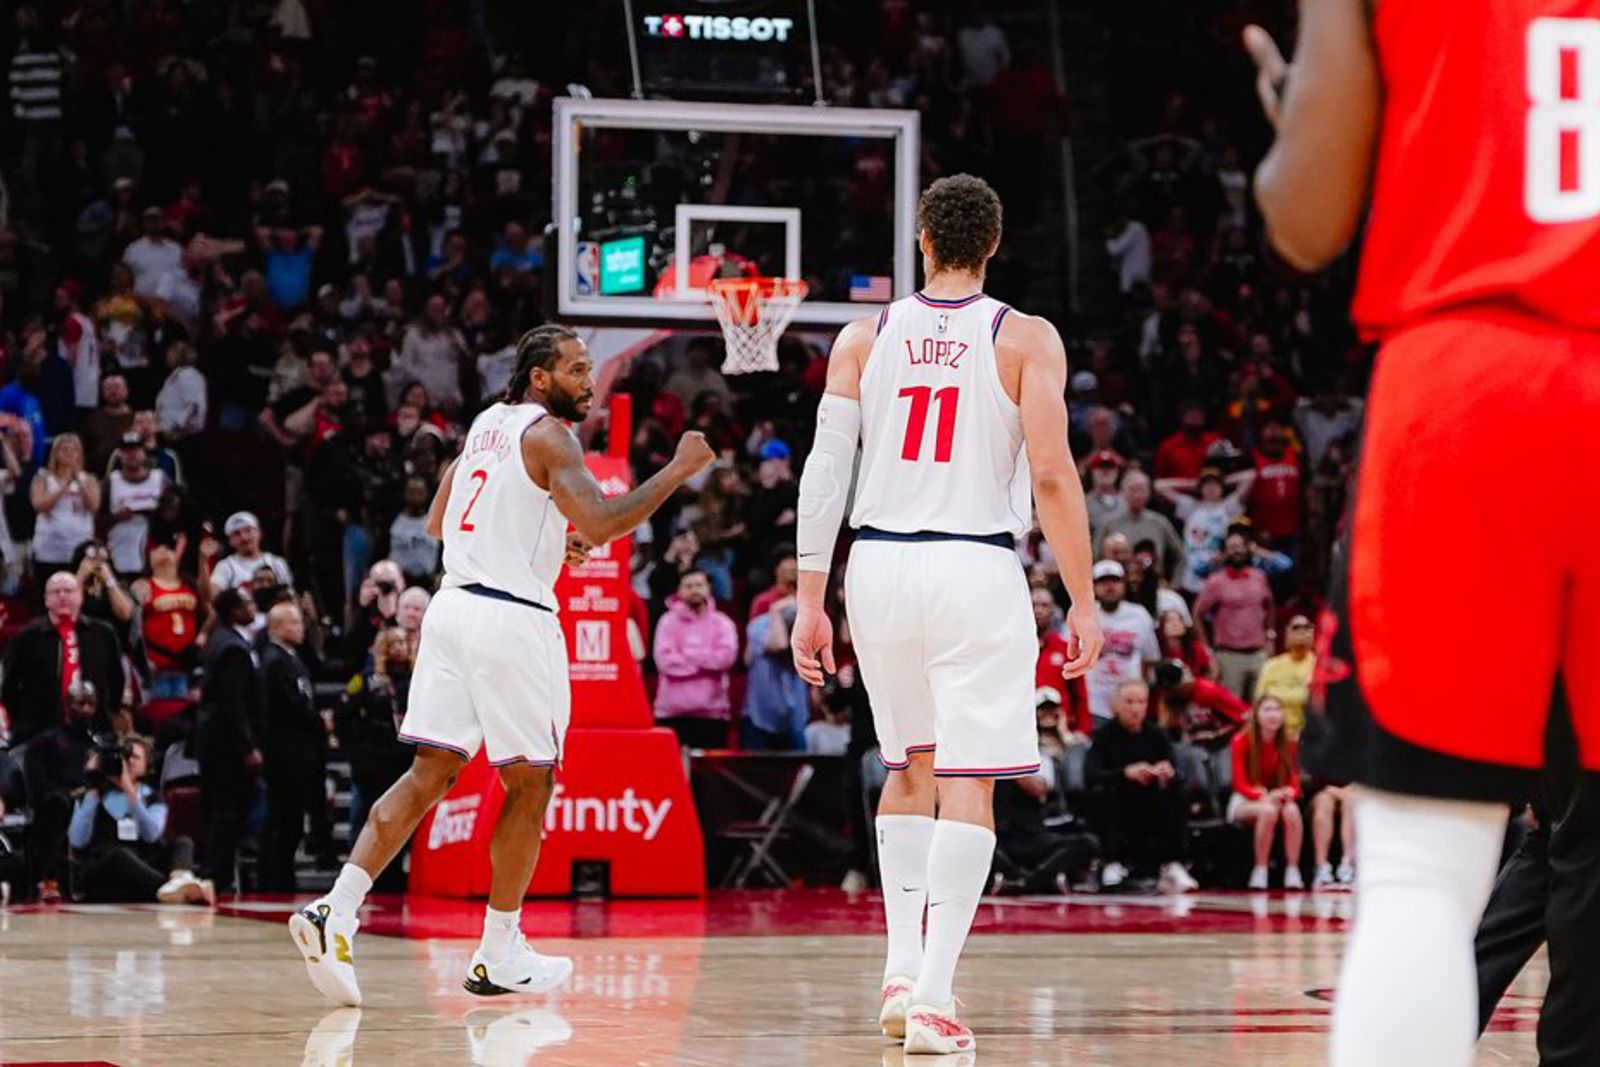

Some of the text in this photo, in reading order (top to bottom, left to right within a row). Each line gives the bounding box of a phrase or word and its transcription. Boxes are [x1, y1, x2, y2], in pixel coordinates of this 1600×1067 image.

[684, 15, 793, 42] TISSOT
[1524, 16, 1600, 224] 8
[905, 338, 968, 369] LOPEZ
[898, 385, 960, 463] 11
[459, 469, 488, 532] 2
[541, 783, 673, 840] finity
